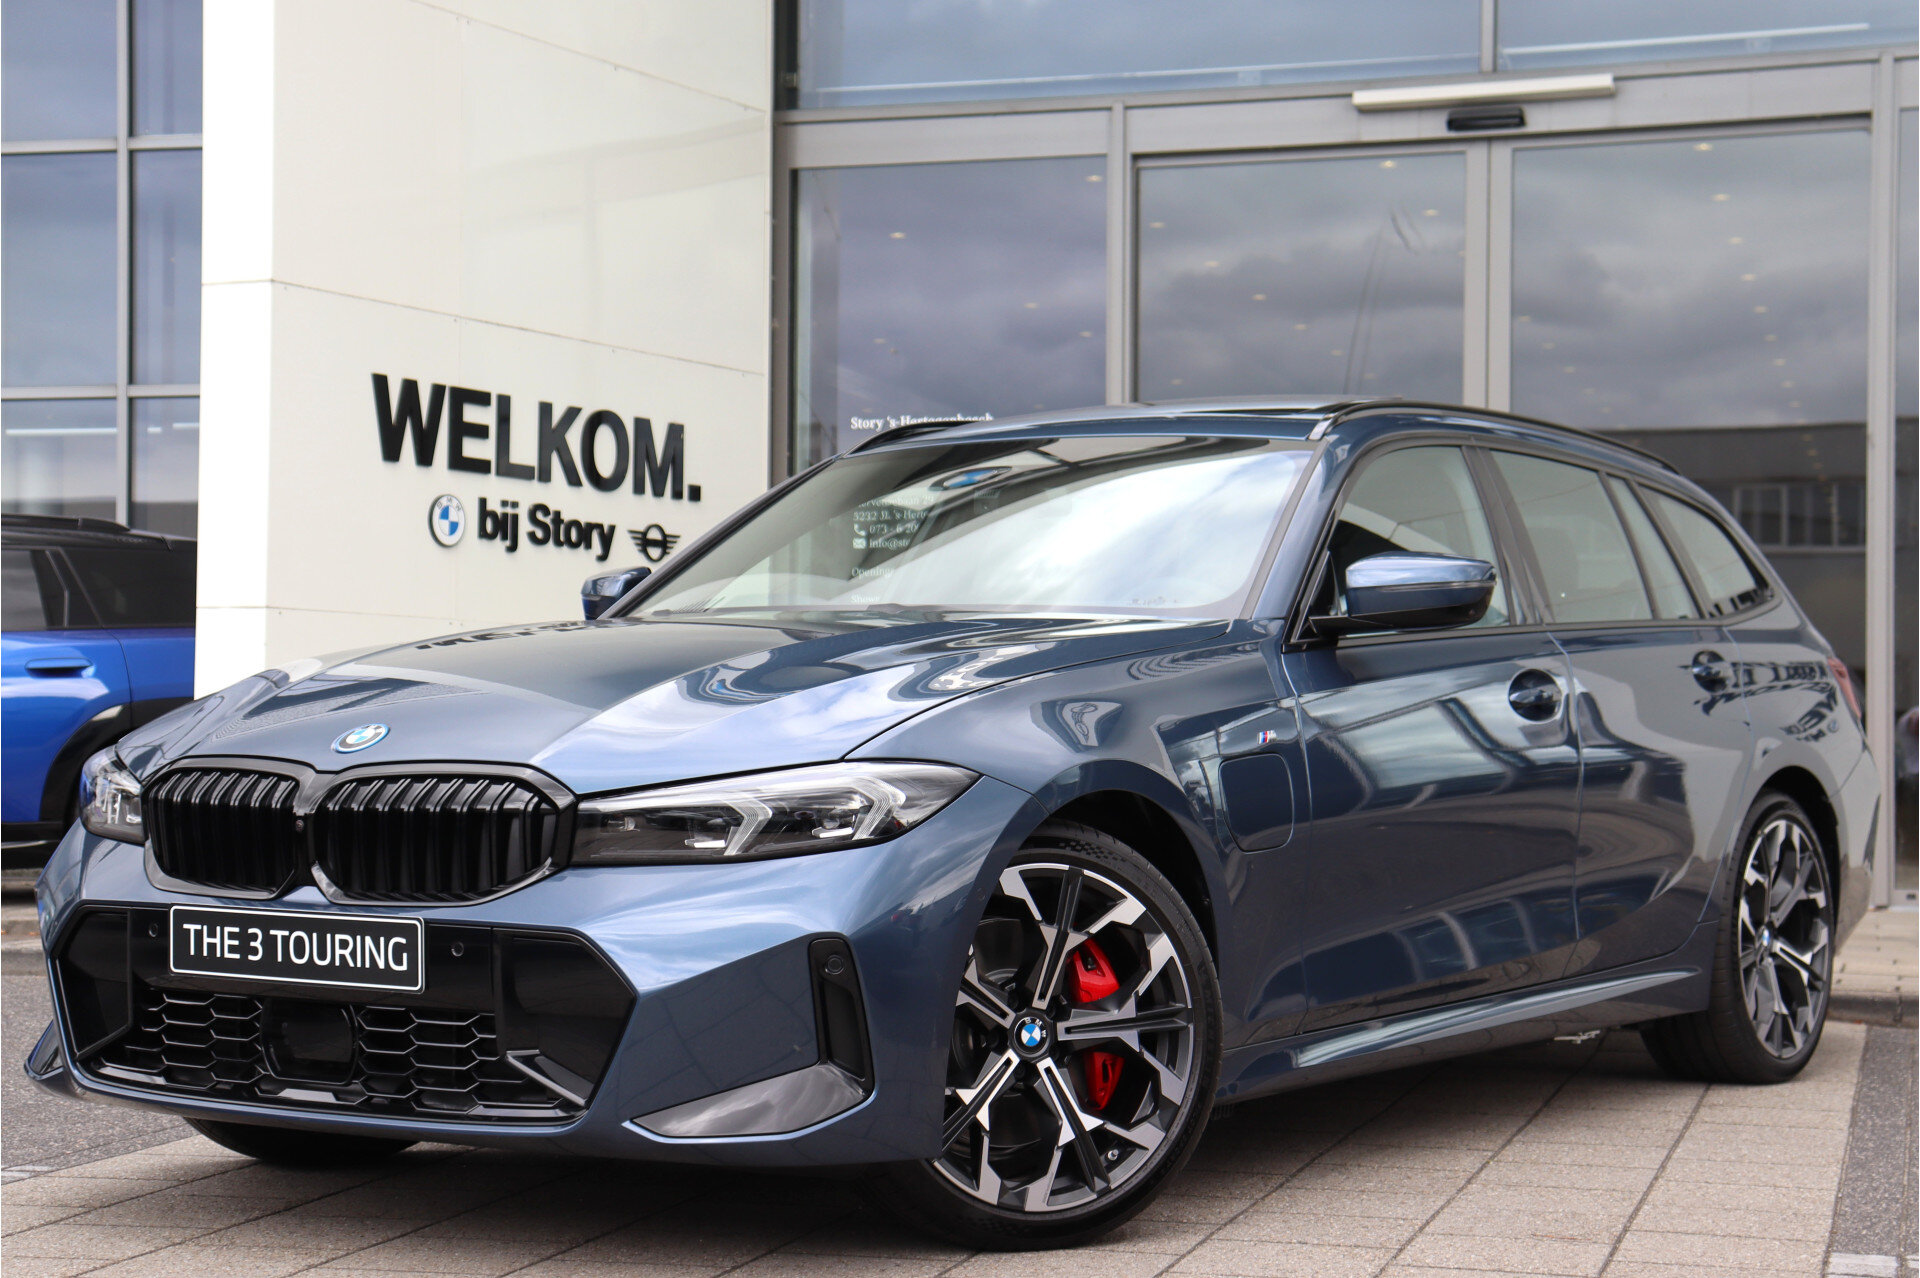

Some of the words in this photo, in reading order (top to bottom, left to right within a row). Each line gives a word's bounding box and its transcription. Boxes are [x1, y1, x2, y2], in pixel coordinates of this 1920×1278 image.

[371, 372, 702, 503] WELKOM.
[850, 416, 884, 432] Story
[477, 496, 519, 553] bij
[526, 502, 616, 562] Story
[182, 923, 241, 960] THE
[247, 928, 263, 962] 3
[269, 929, 408, 972] TOURING
